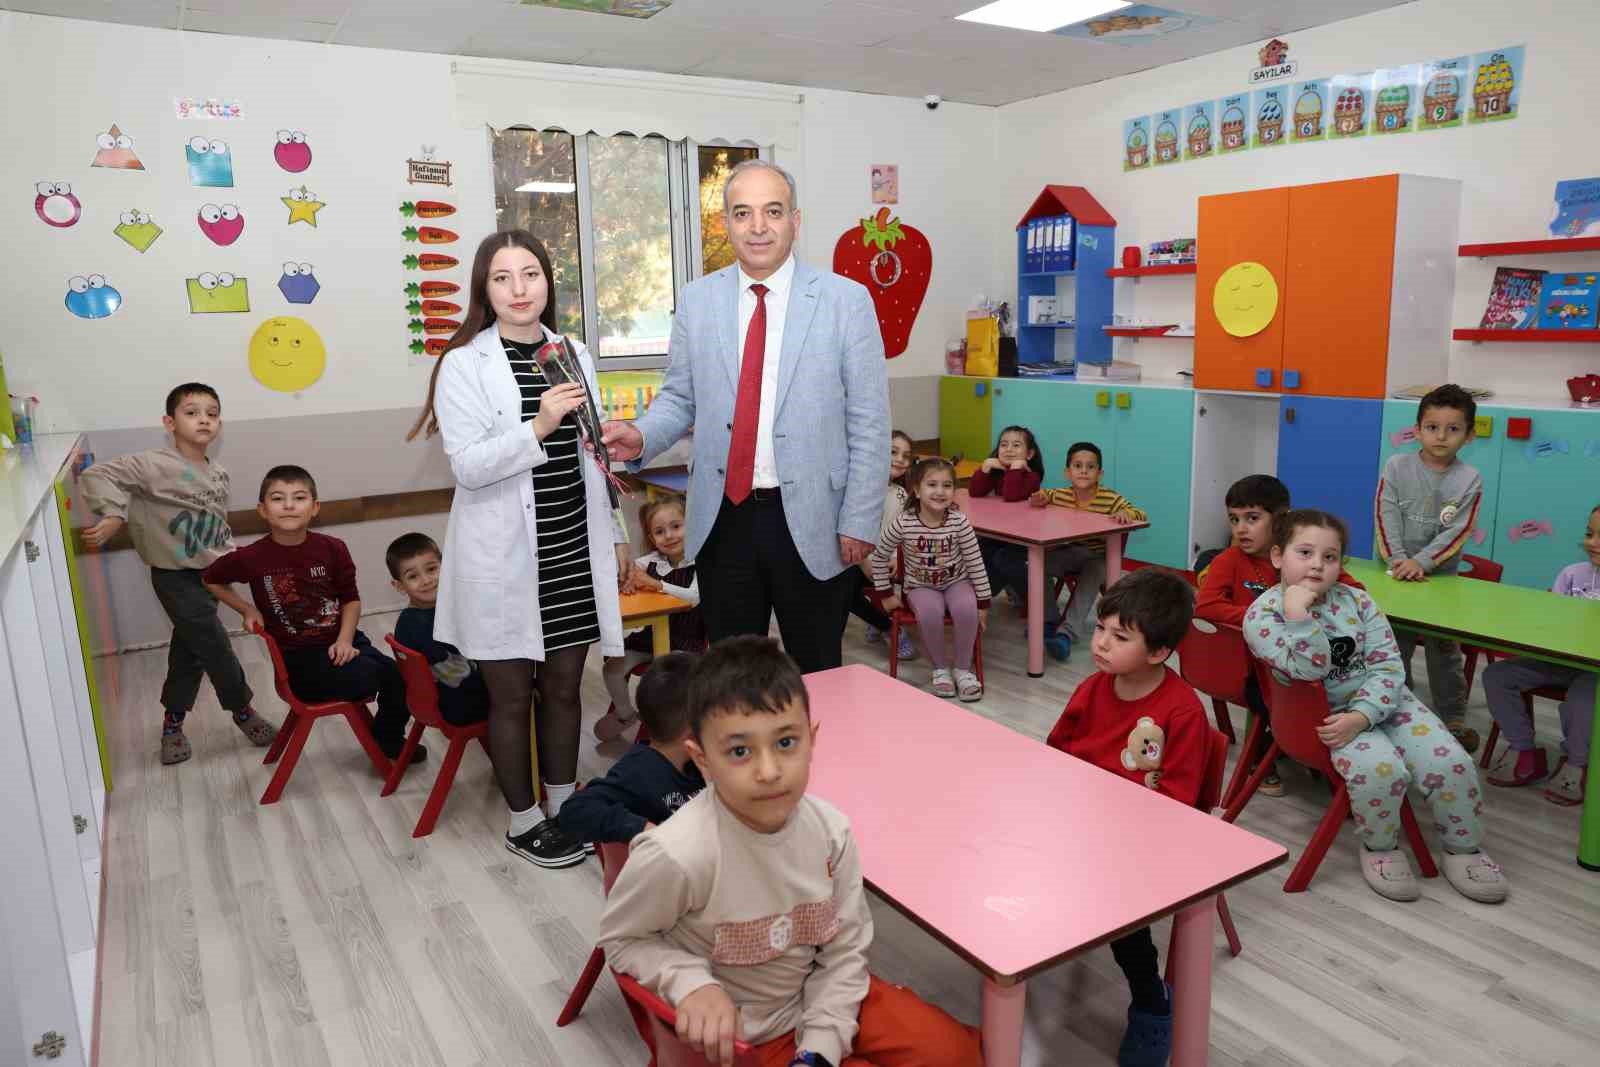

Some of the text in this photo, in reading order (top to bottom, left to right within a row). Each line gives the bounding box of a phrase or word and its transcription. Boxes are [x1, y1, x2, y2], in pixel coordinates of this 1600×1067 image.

[1490, 53, 1504, 64] On
[1253, 64, 1292, 81] SAYILAR
[1483, 98, 1500, 113] 10
[1435, 105, 1446, 119] 9
[1267, 128, 1274, 140] 5
[1303, 123, 1312, 134] 6
[1229, 135, 1237, 144] 4
[310, 566, 327, 577] NYC
